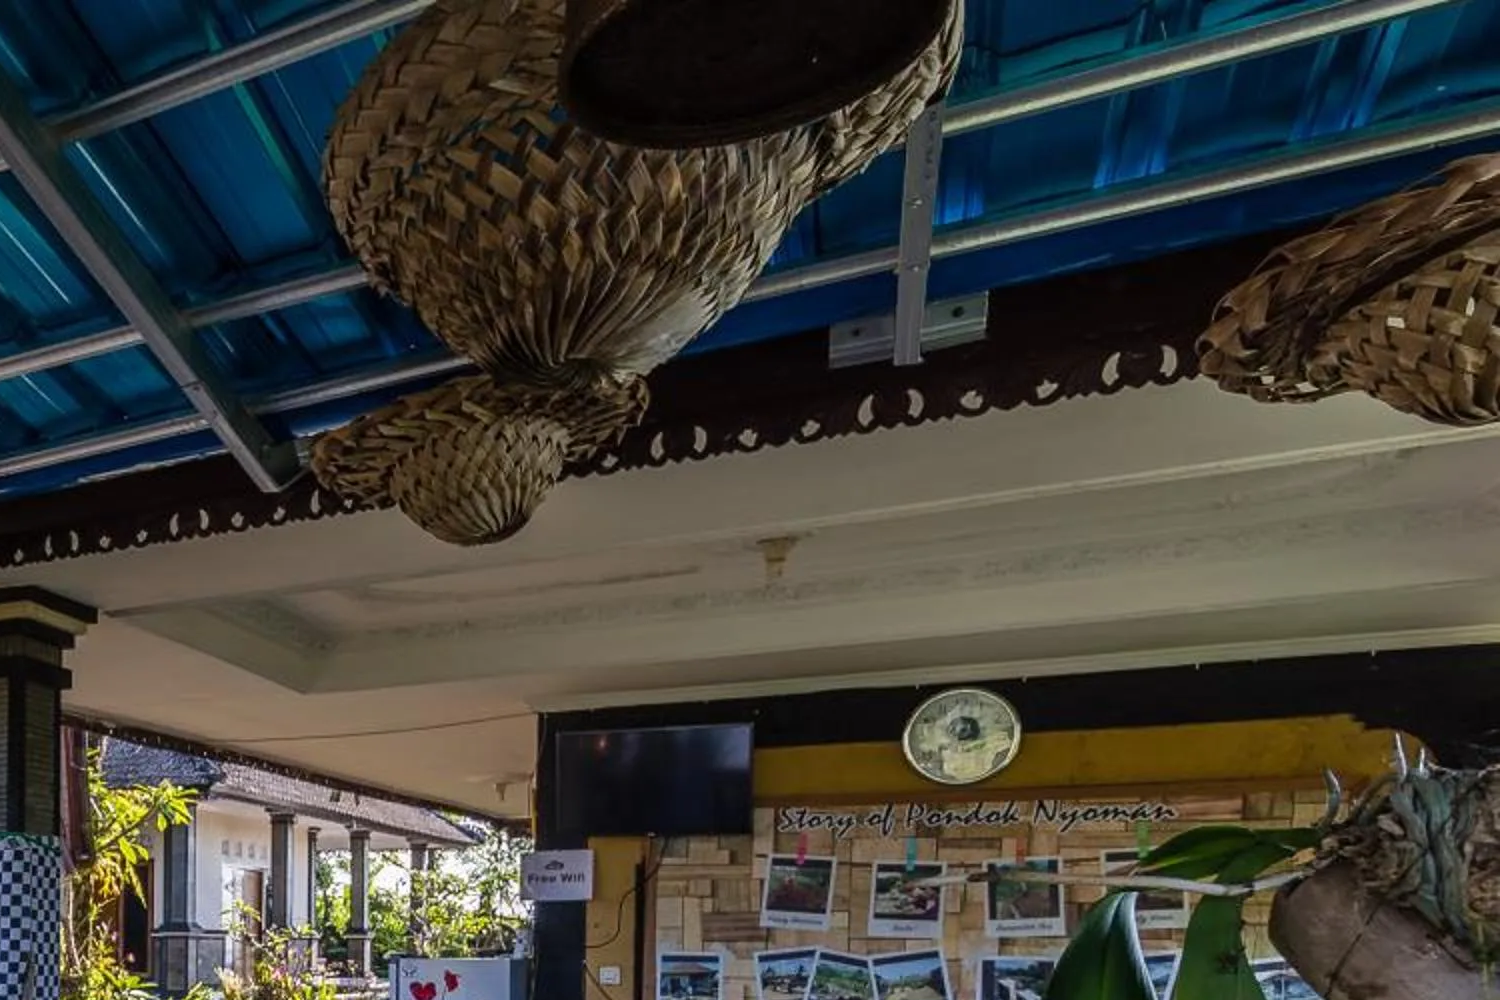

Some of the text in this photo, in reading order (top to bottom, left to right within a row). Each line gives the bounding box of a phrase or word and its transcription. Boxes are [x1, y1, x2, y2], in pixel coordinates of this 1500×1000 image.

[778, 799, 1178, 837] Story of Pondok Nyoman
